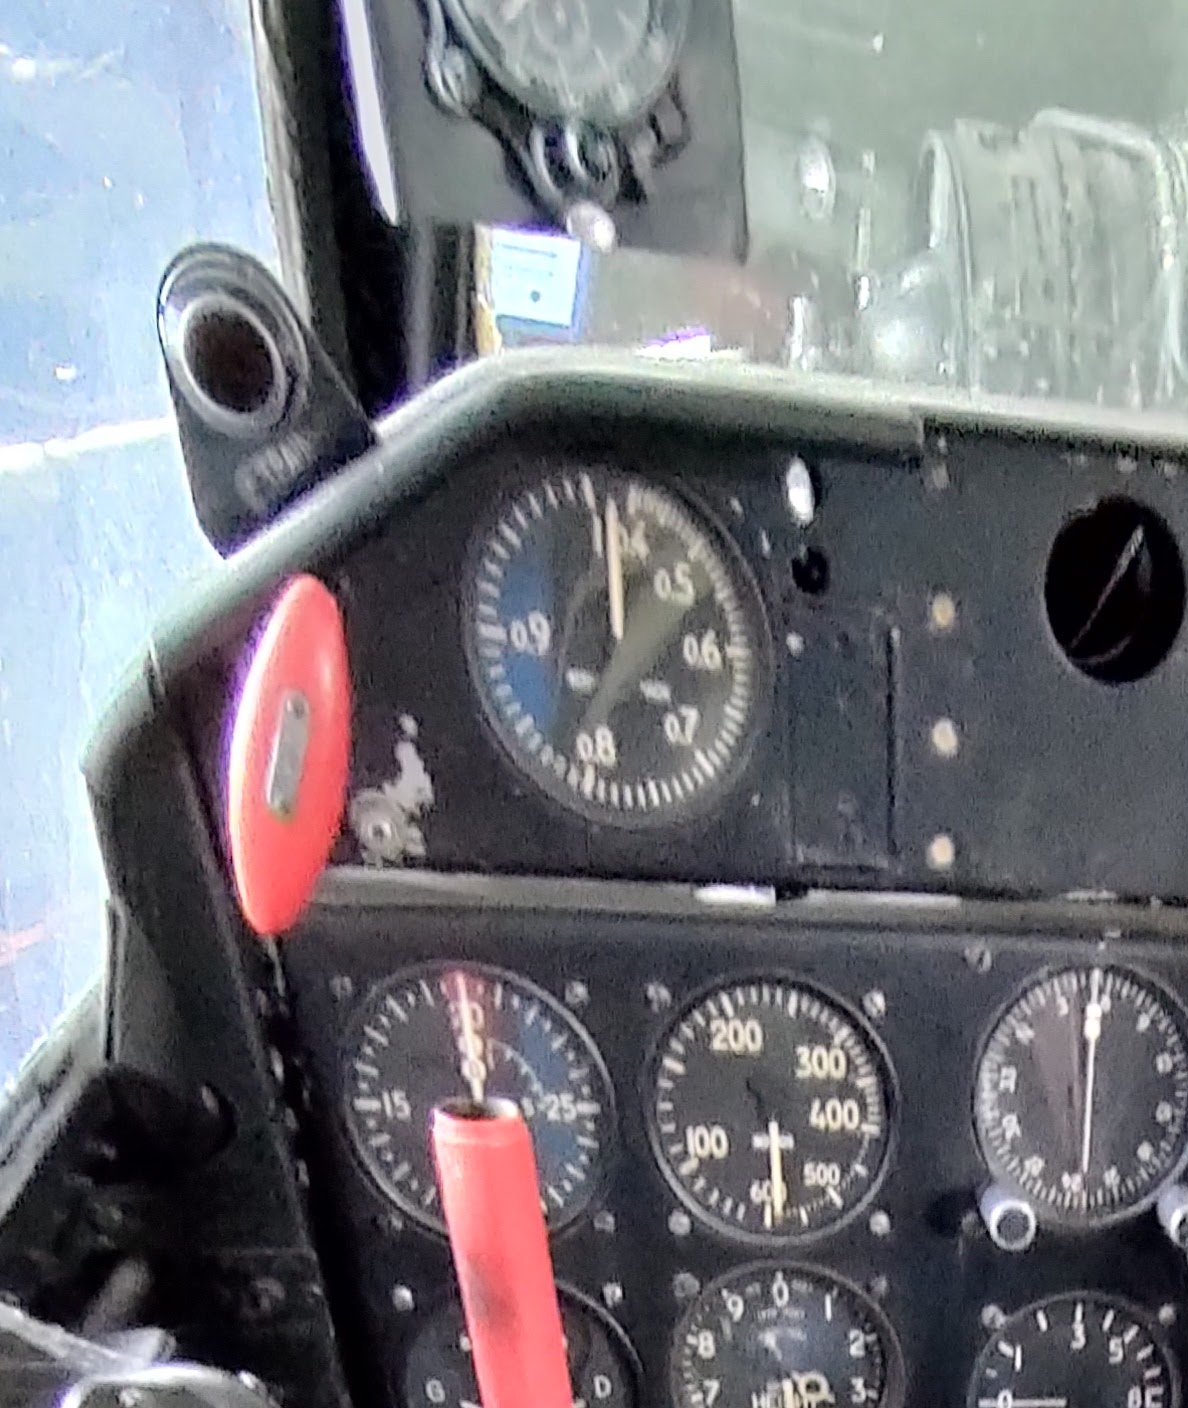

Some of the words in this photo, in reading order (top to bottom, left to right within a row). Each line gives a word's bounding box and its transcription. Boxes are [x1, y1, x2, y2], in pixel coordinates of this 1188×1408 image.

[709, 1018, 764, 1055] 200
[796, 1045, 848, 1080] 300
[809, 1097, 860, 1134] 400
[685, 1124, 729, 1159] 100
[803, 1162, 841, 1187] 500
